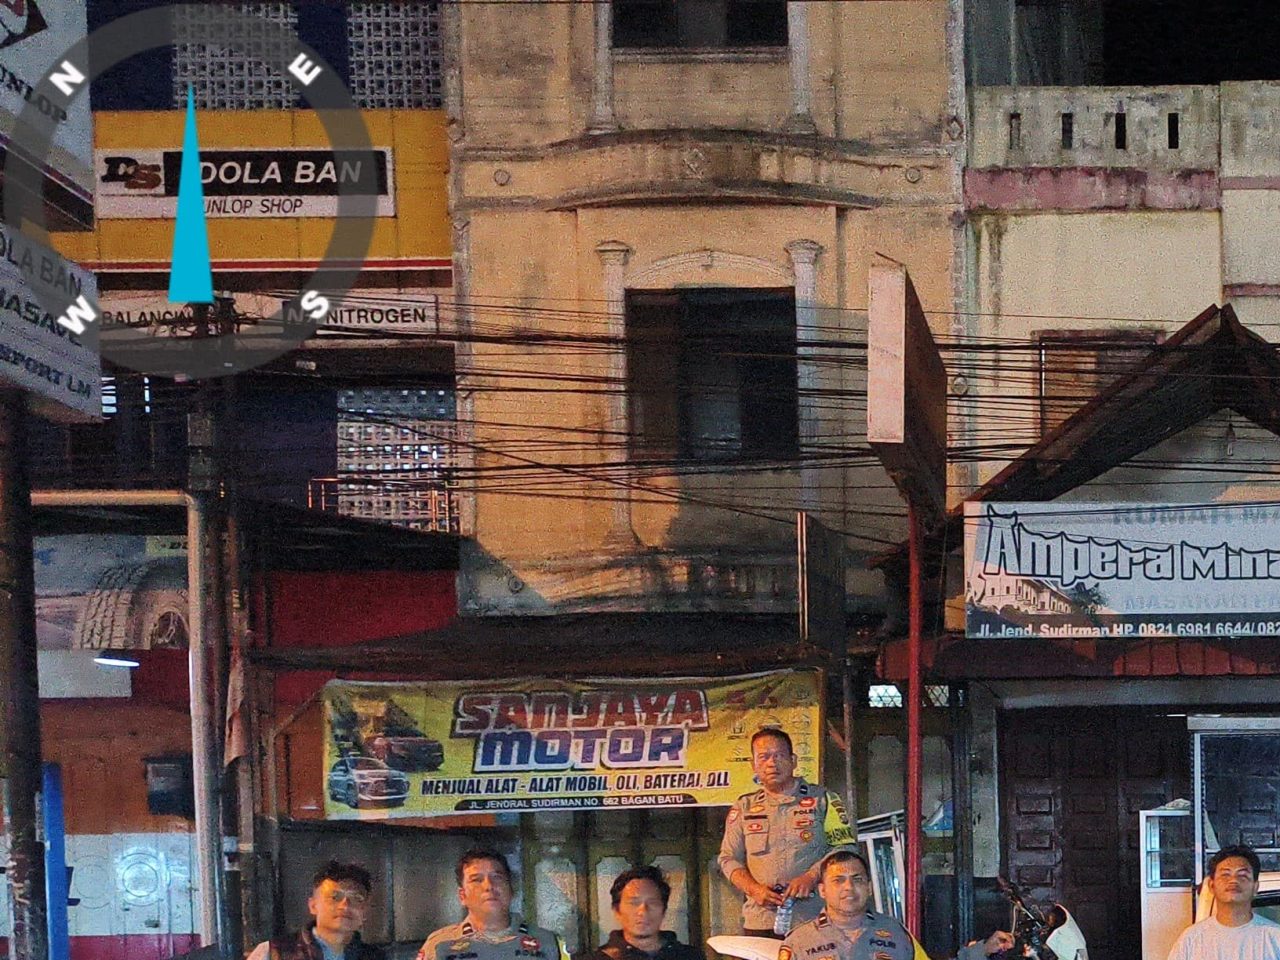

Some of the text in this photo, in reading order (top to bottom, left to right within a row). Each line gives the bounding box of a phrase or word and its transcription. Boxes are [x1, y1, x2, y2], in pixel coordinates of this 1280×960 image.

[295, 161, 362, 183] BAN
[204, 199, 303, 214] UNLOP SHOP
[326, 308, 427, 325] NITROGEN
[1039, 623, 1110, 637] Sudirman
[1138, 622, 1173, 636] 0821
[1176, 622, 1211, 636] 6981
[457, 690, 707, 733] SANJAYA
[477, 727, 688, 770] MOTOR
[421, 780, 482, 795] MENJUAL
[484, 779, 518, 794] ALAT
[528, 778, 561, 792] ALAT
[564, 776, 613, 793] MOBIL,
[531, 798, 583, 808] SUDIRMAN
[621, 796, 656, 805] BAGAN
[657, 795, 684, 804] BATU
[805, 942, 837, 956] YAKUB
